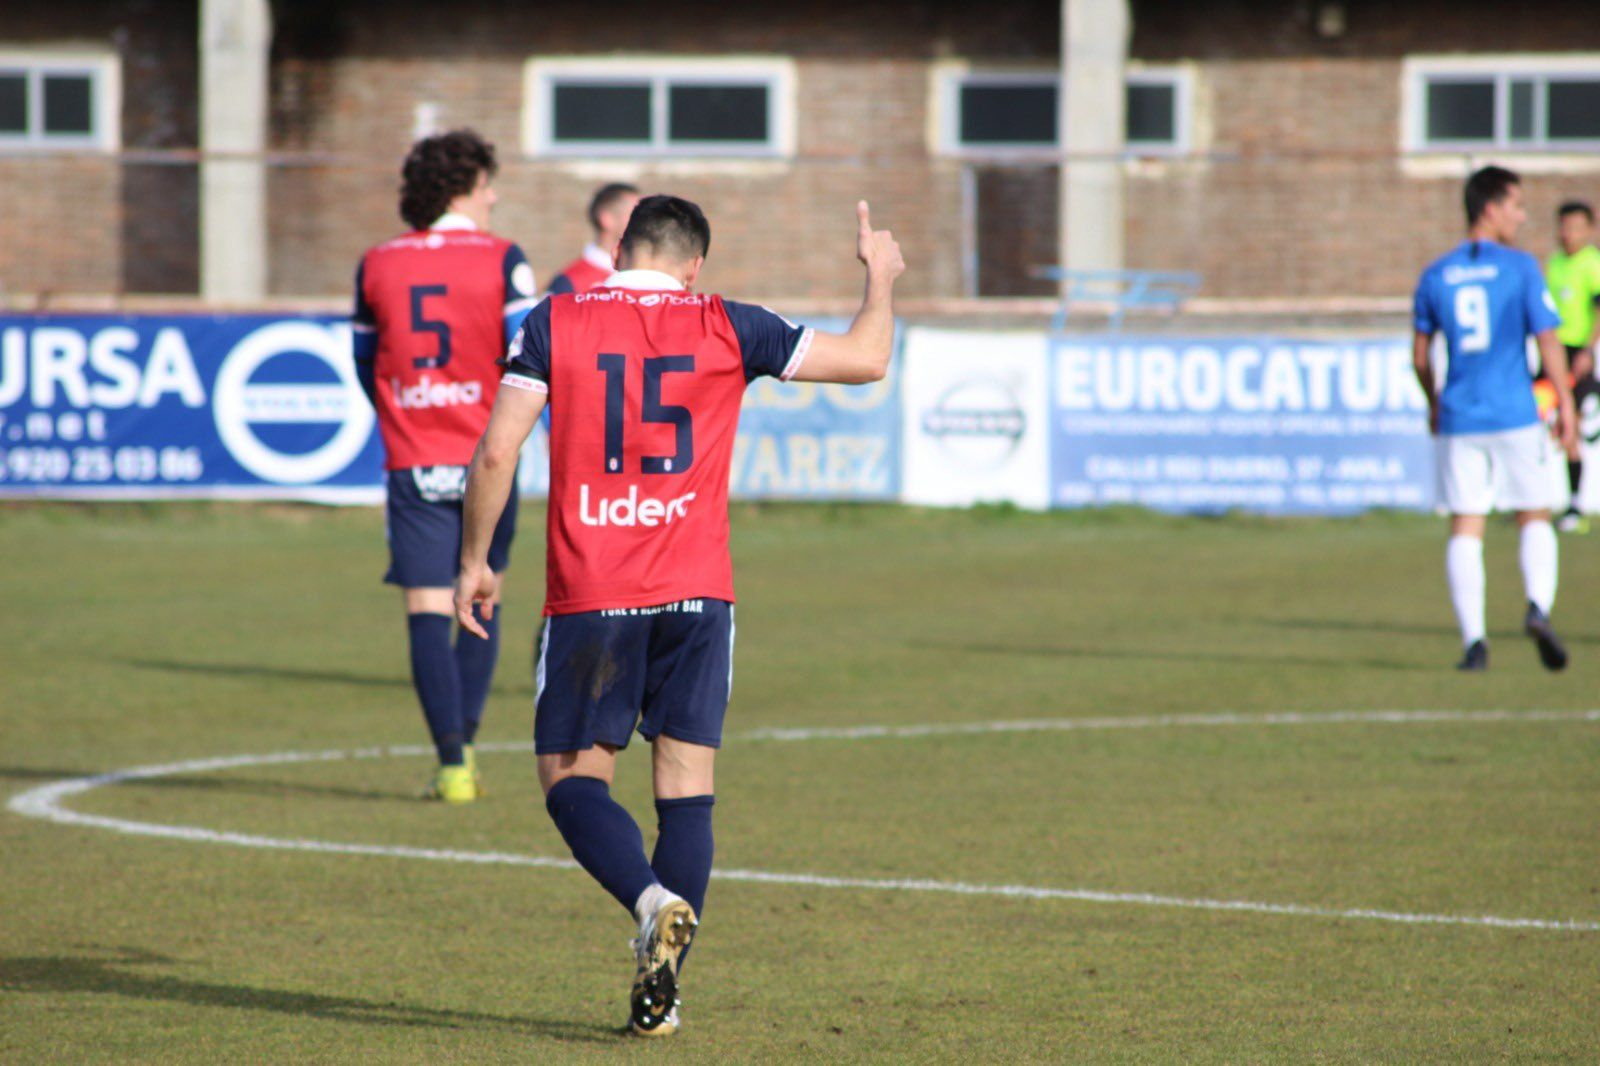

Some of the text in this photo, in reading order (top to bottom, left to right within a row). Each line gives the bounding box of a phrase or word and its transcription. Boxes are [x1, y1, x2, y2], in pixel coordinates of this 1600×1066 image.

[411, 284, 453, 369] 5
[1454, 285, 1490, 352] 9
[597, 353, 695, 474] 15
[682, 599, 703, 613] BAR
